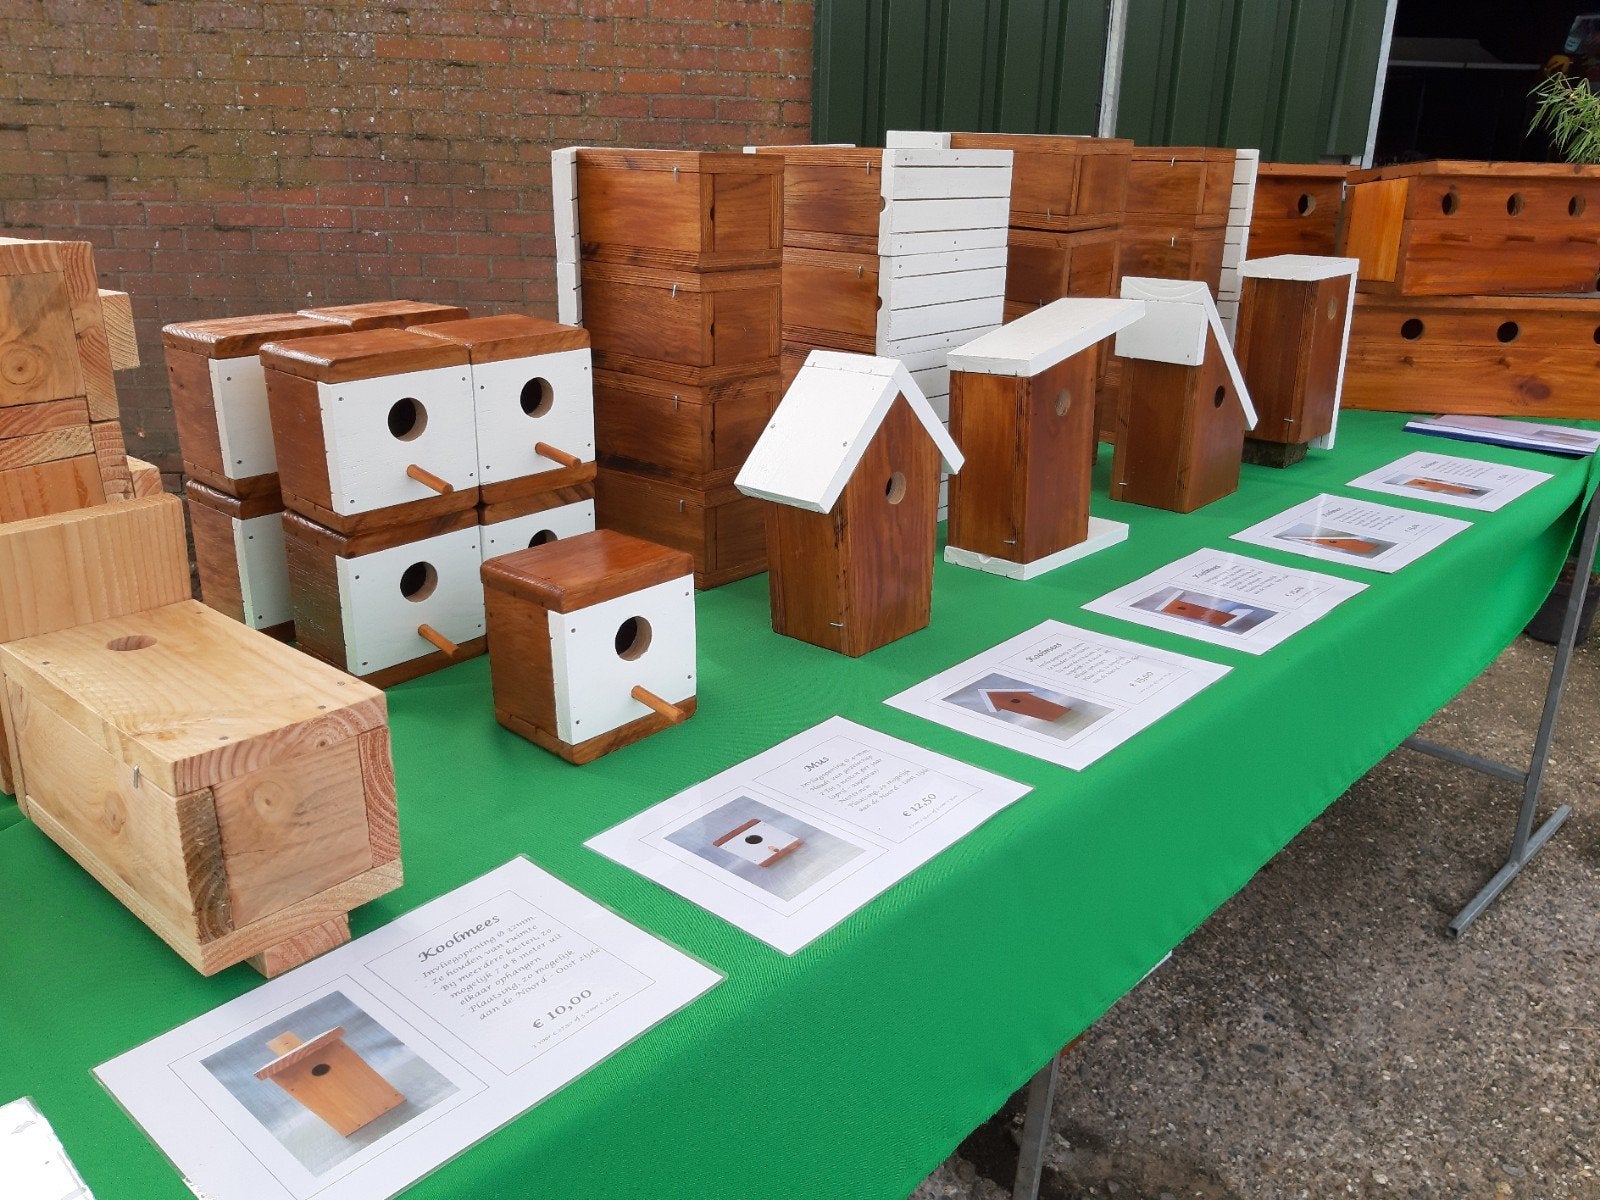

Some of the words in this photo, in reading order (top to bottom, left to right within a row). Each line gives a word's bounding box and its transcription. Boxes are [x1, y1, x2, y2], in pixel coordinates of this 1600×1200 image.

[803, 756, 829, 772] Mus
[910, 793, 936, 811] 12,50
[418, 915, 500, 962] Koolmees
[422, 936, 496, 978] Invliegopening
[440, 981, 457, 991] Bij
[458, 954, 503, 982] meerdere
[540, 928, 551, 936] zo
[445, 955, 483, 976] houden
[484, 943, 503, 954] van
[505, 925, 536, 943] ruimte
[450, 972, 492, 998] mogelijk
[518, 941, 545, 959] meter
[548, 933, 561, 942] uit
[460, 984, 490, 1005] elkaar
[494, 957, 541, 985] ophangen
[479, 1006, 499, 1020] aan
[502, 997, 512, 1006] de
[515, 976, 547, 995] Noord
[555, 960, 575, 973] Oost
[579, 947, 600, 961] zijde
[521, 973, 532, 982] zo
[534, 950, 573, 974] mogelijk
[532, 1018, 543, 1028] €
[546, 989, 591, 1020] 10,00
